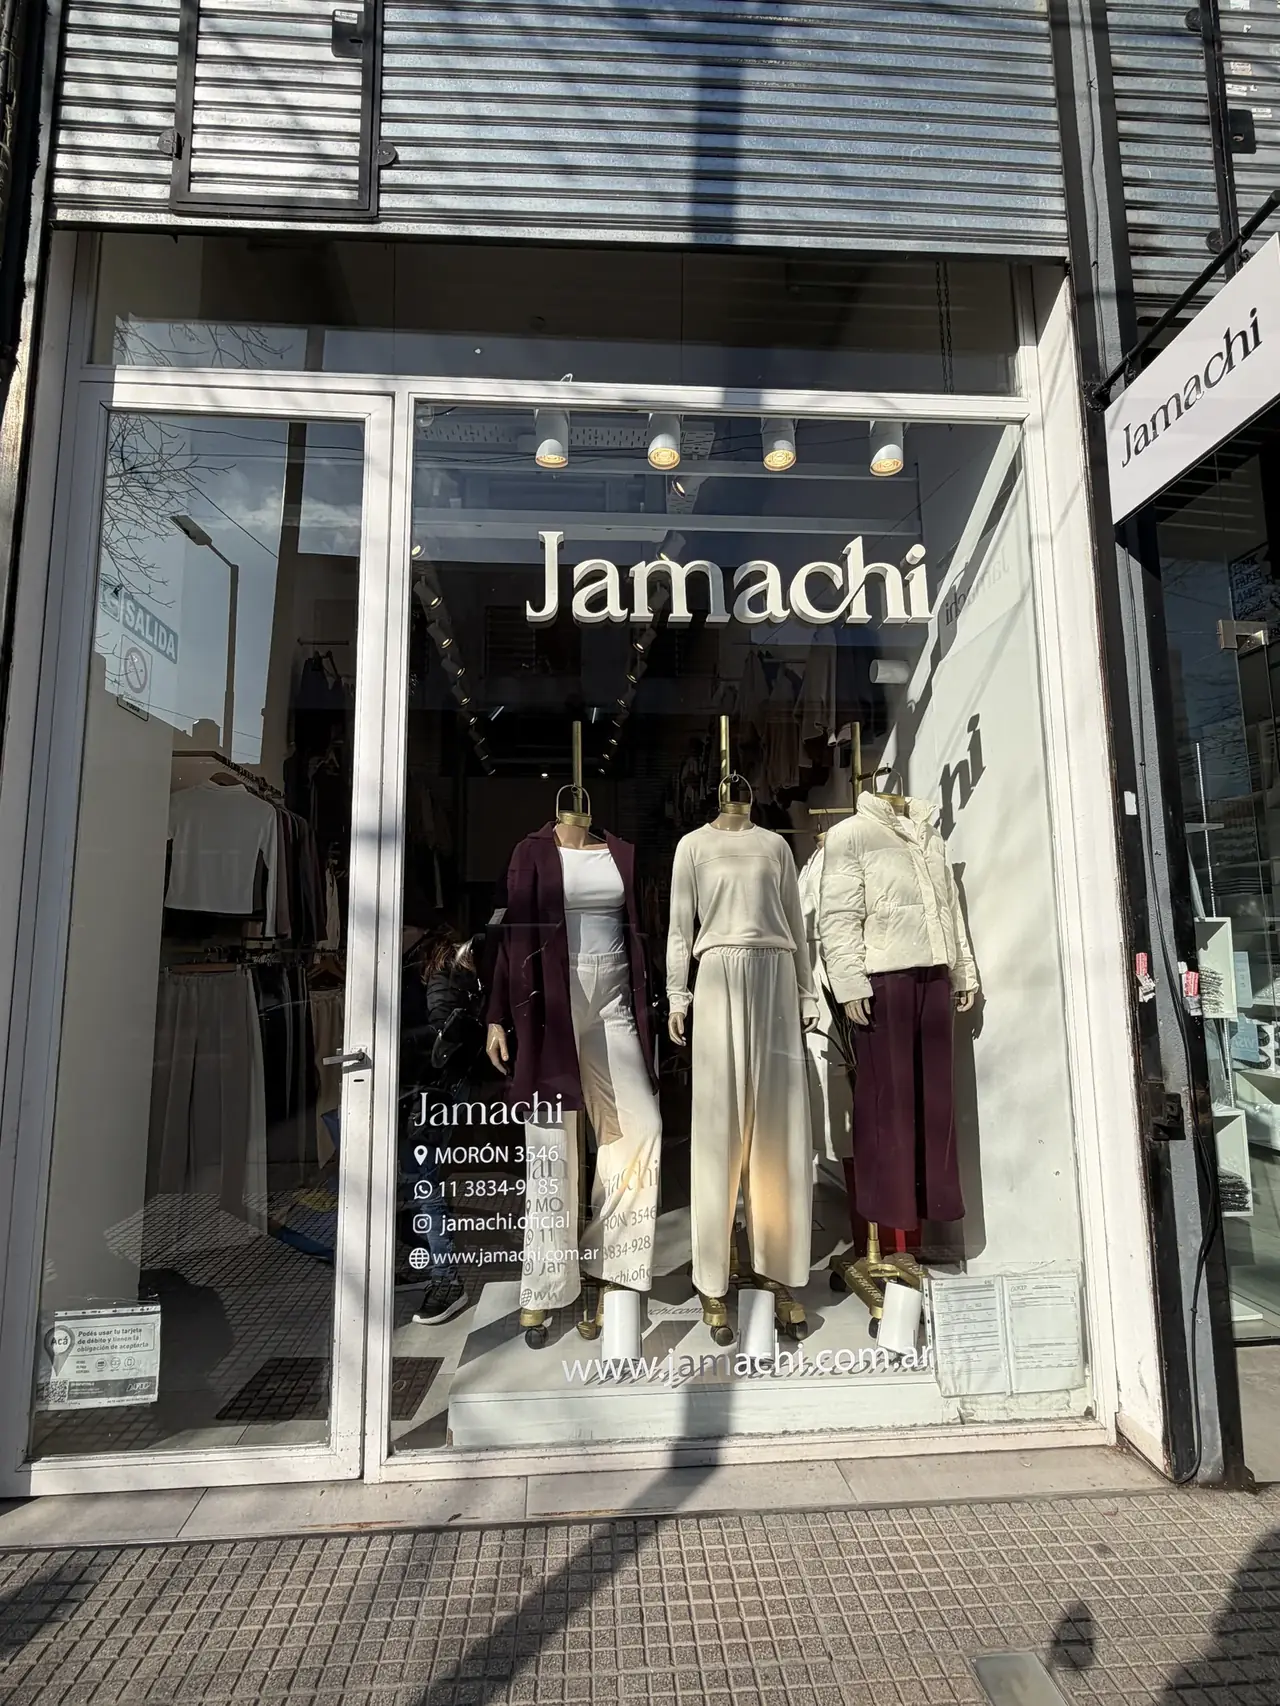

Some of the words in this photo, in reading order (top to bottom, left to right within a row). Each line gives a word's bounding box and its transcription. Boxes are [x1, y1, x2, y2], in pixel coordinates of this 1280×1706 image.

[1121, 307, 1263, 468] Jamachi
[526, 531, 935, 626] Jamachi
[124, 599, 176, 660] SALIDA
[414, 1091, 563, 1127] Jamachi
[434, 1143, 509, 1163] MORÓN
[514, 1145, 559, 1163] 3546
[439, 1181, 457, 1197] 11
[464, 1179, 559, 1197] 3834-985
[439, 1211, 570, 1235] jamachi.oficial
[433, 1247, 599, 1267] www.jamachi.com.ar
[51, 1335, 69, 1346] Acá
[561, 1342, 934, 1387] www.jamachi.com.ar
